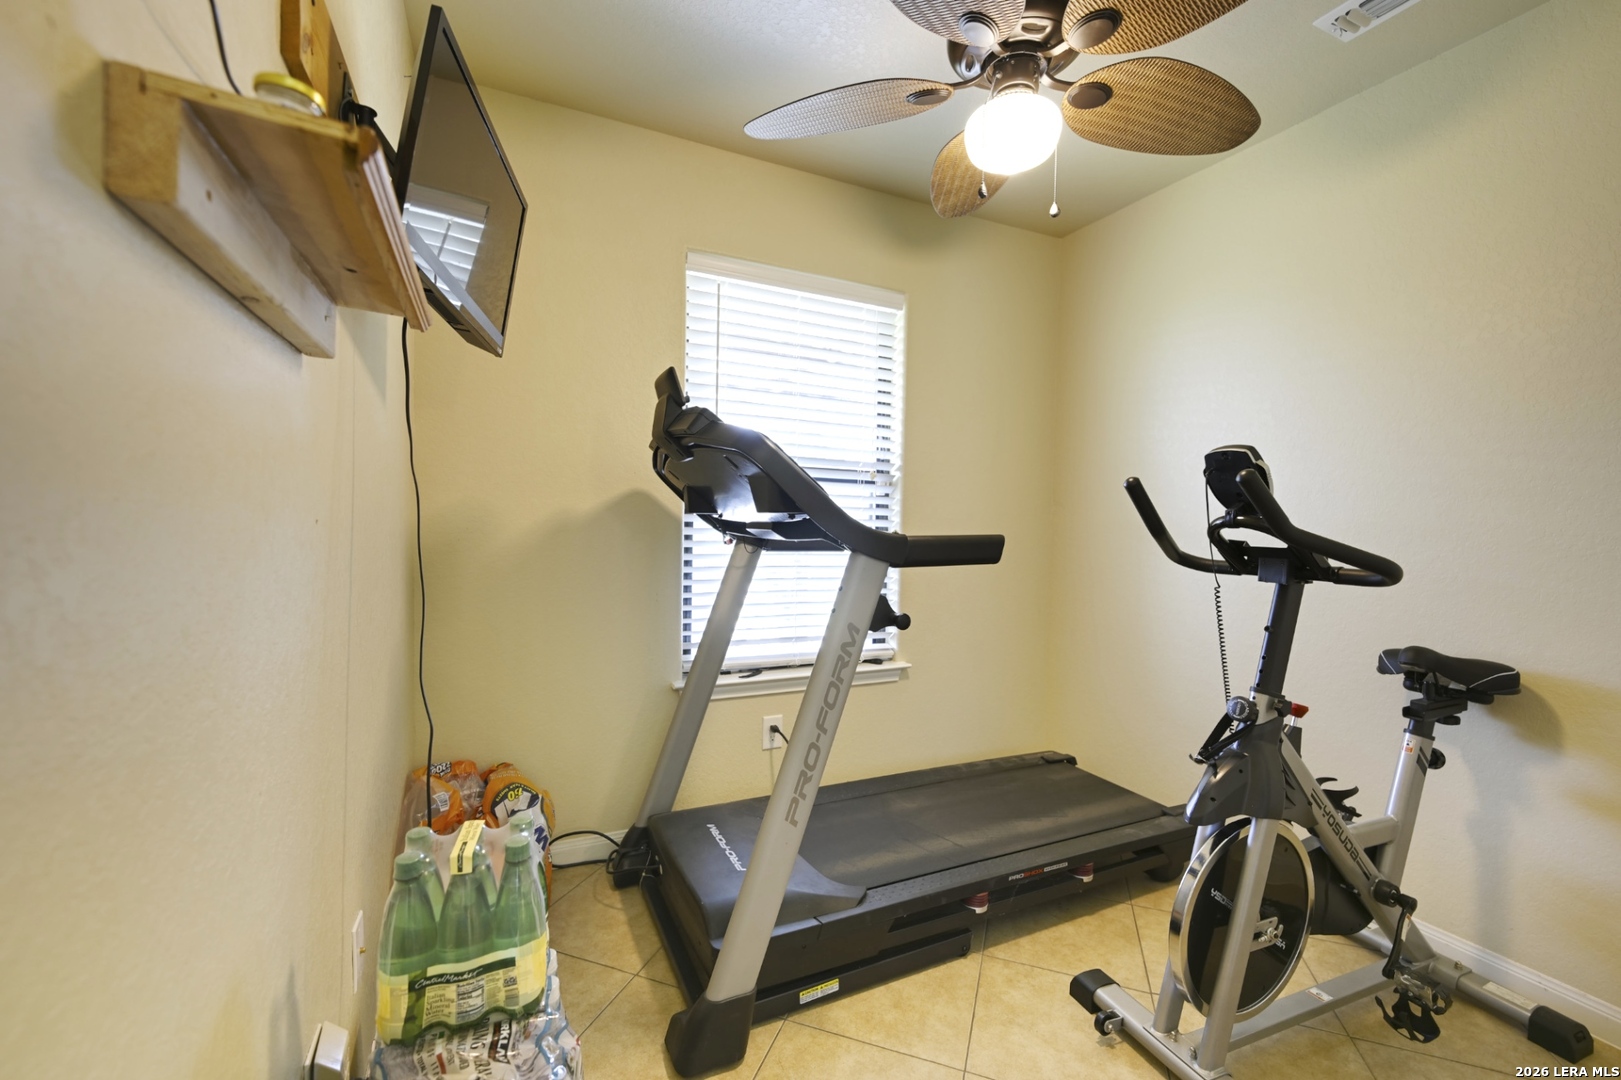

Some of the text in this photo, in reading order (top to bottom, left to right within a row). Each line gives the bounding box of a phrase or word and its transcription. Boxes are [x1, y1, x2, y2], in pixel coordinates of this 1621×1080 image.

[785, 622, 861, 828] PRO-FORM
[706, 824, 747, 871] PRO-FORM
[1322, 804, 1359, 862] YOSUDA
